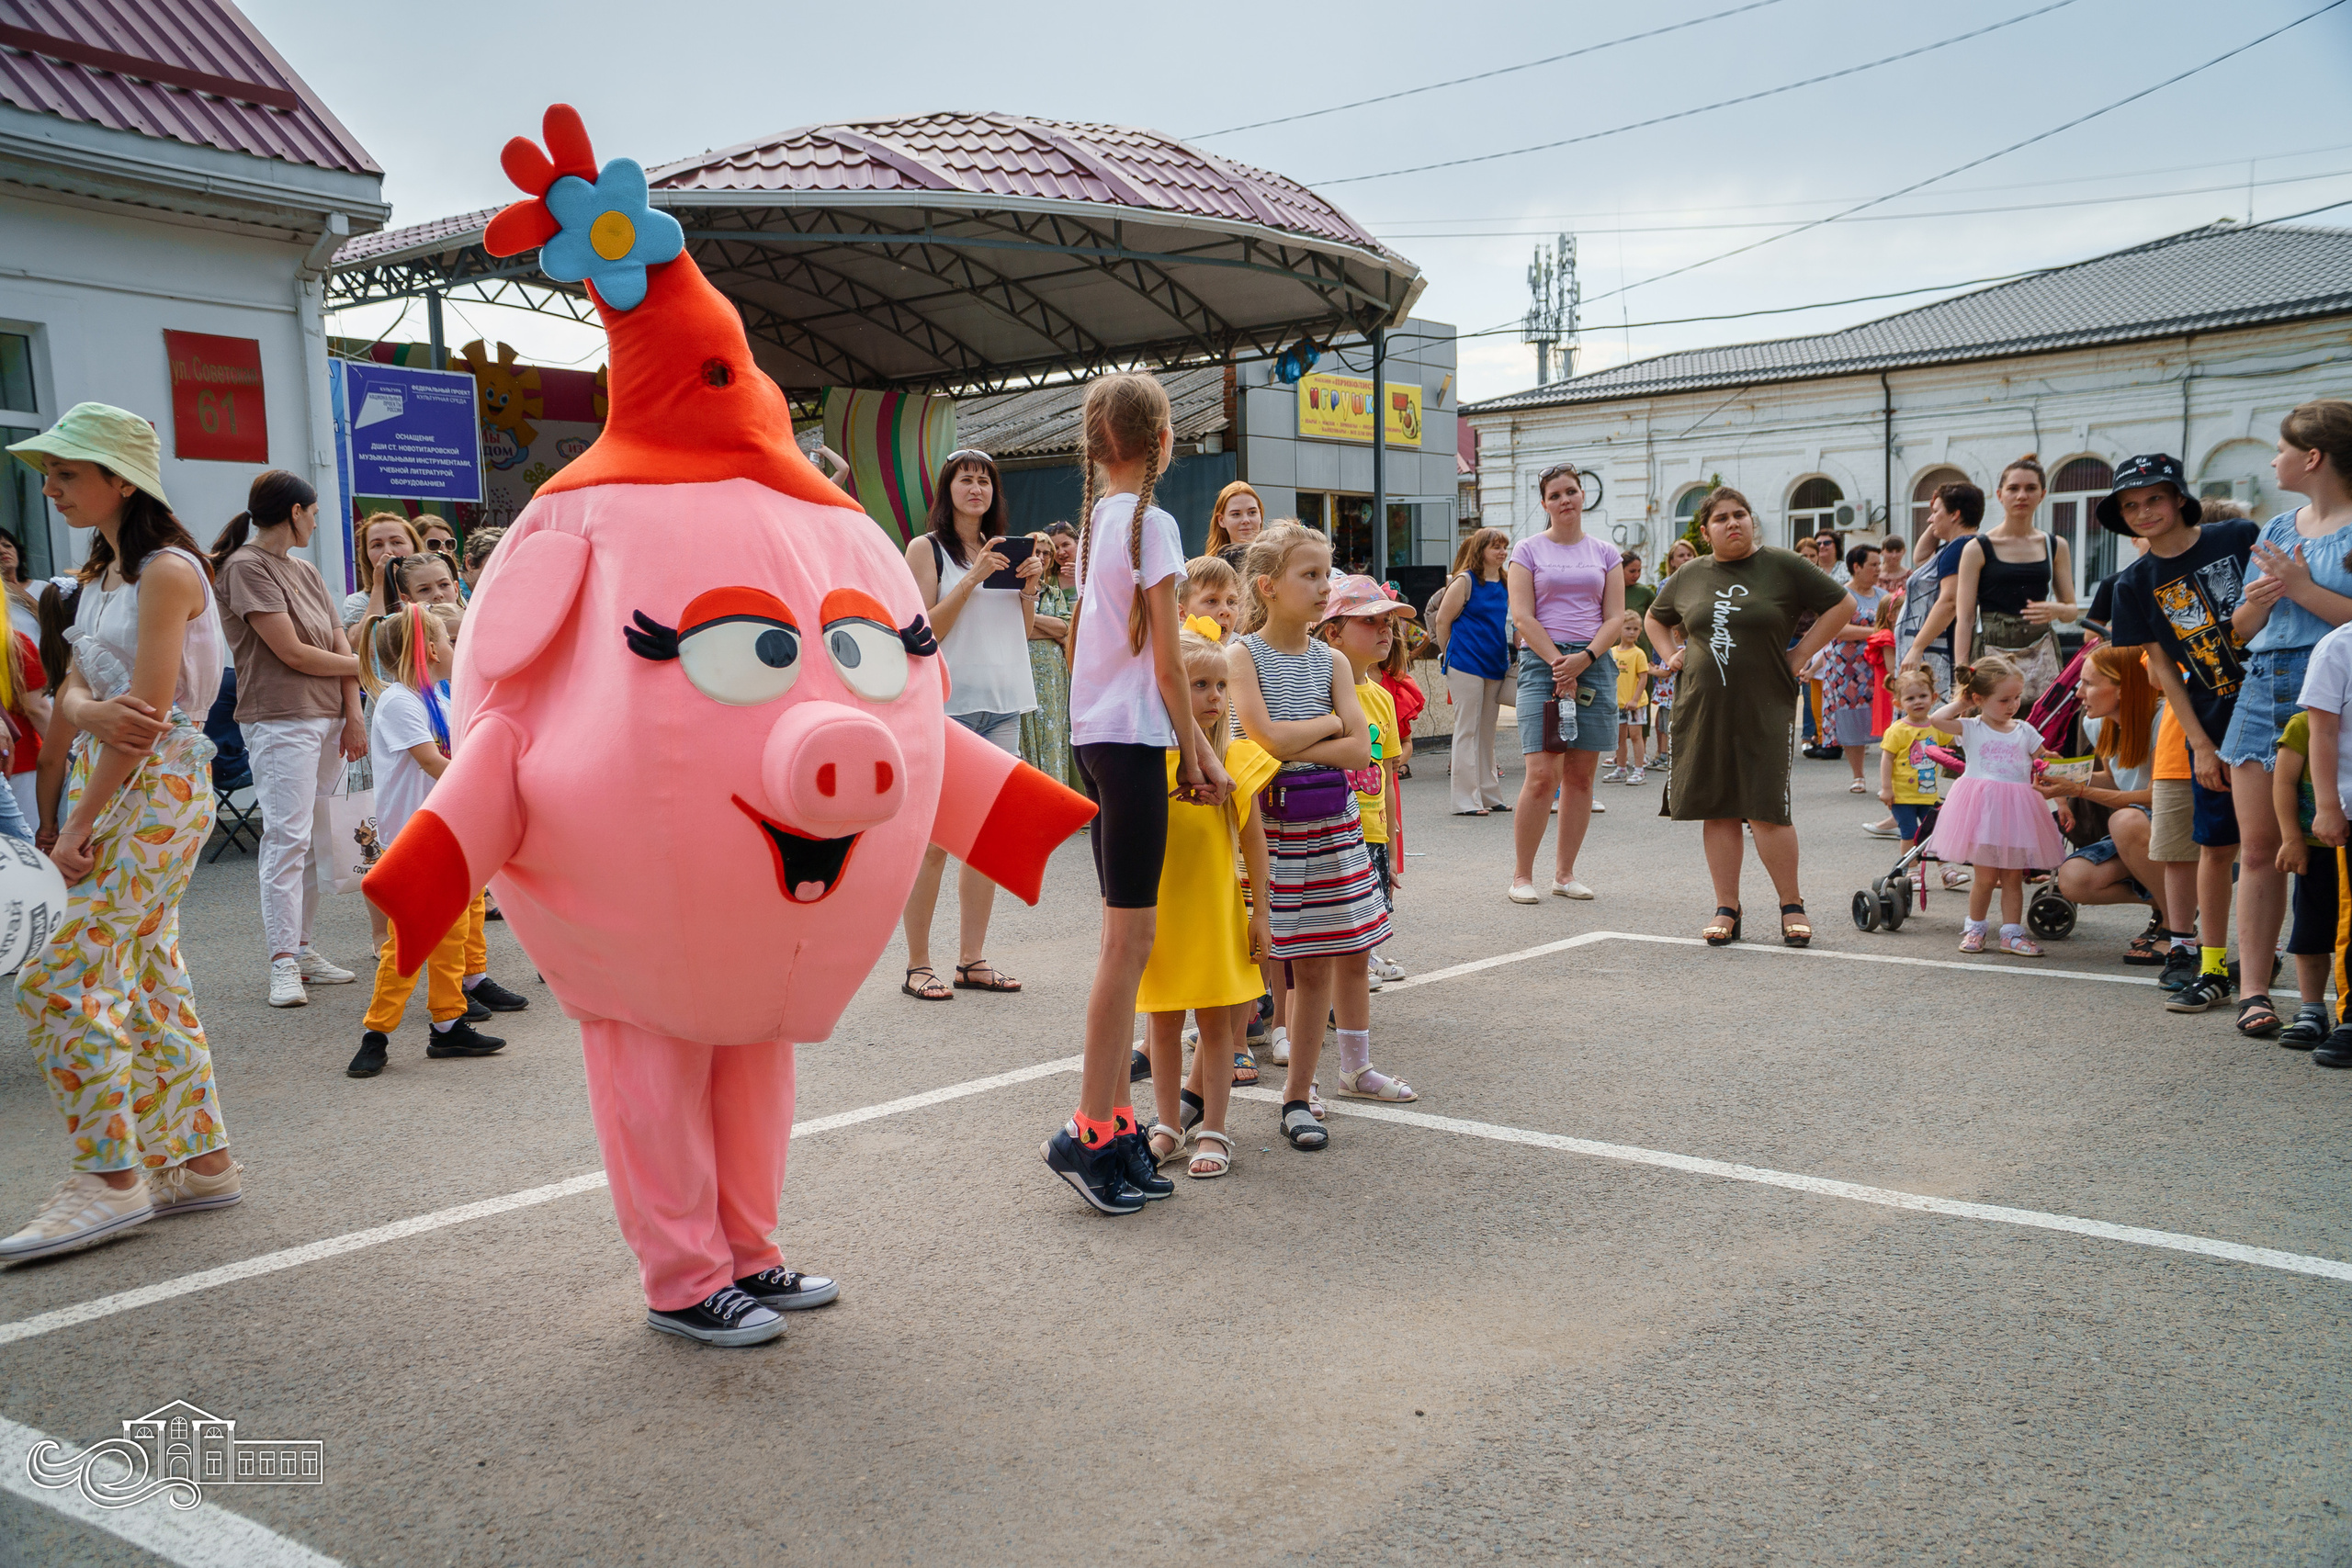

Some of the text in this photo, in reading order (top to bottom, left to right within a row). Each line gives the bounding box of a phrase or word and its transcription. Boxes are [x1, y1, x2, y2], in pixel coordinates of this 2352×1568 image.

[171, 359, 191, 386] ул.
[411, 384, 450, 394] ФЕДЕРАЛЬНЫЙ
[416, 394, 468, 405] КУЛЬТУРНАЯ СРЕДА
[1309, 387, 1374, 422] ИГРУШК
[197, 389, 238, 435] 61
[394, 433, 435, 443] ОСНАЩЕНИЕ
[398, 445, 459, 456] НОВОТИТАРОВСКОЙ
[358, 453, 472, 468] МУЗЫКАЛЬНЫМИ ИНСТРУМЕНТАМИ,
[379, 466, 455, 478] УЧЕБНОЙ ЛИТЕРАТУРОЙ,
[390, 478, 446, 488] ОБОРУДОВАНИЕМ
